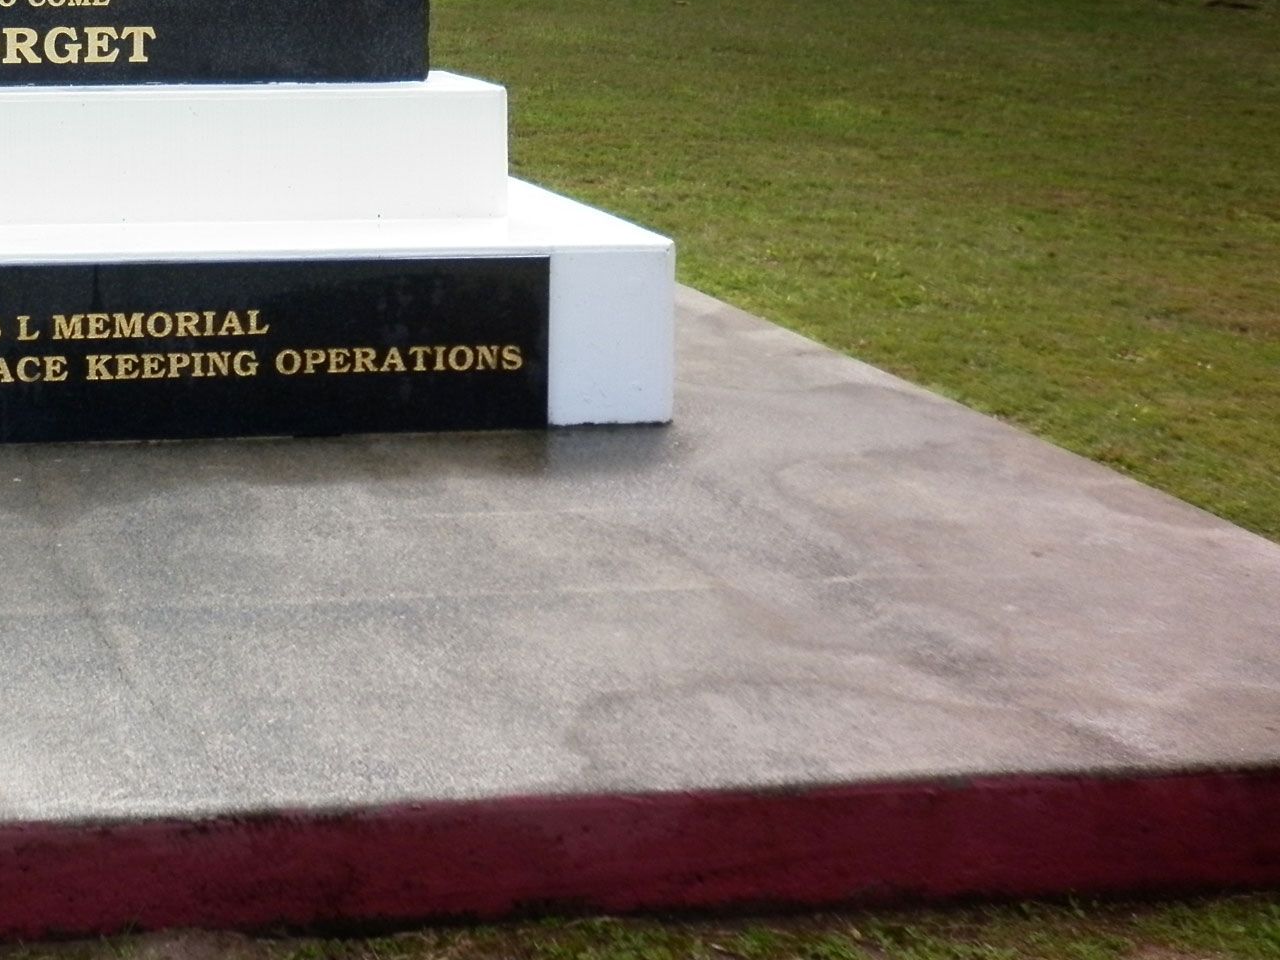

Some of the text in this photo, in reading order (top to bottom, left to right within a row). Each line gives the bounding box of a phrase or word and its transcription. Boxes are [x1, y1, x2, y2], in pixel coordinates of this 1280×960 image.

[16, 315, 41, 341] L
[52, 309, 270, 340] MEMORIAL
[85, 350, 260, 381] KEEPING
[275, 345, 523, 375] OPERATIONS
